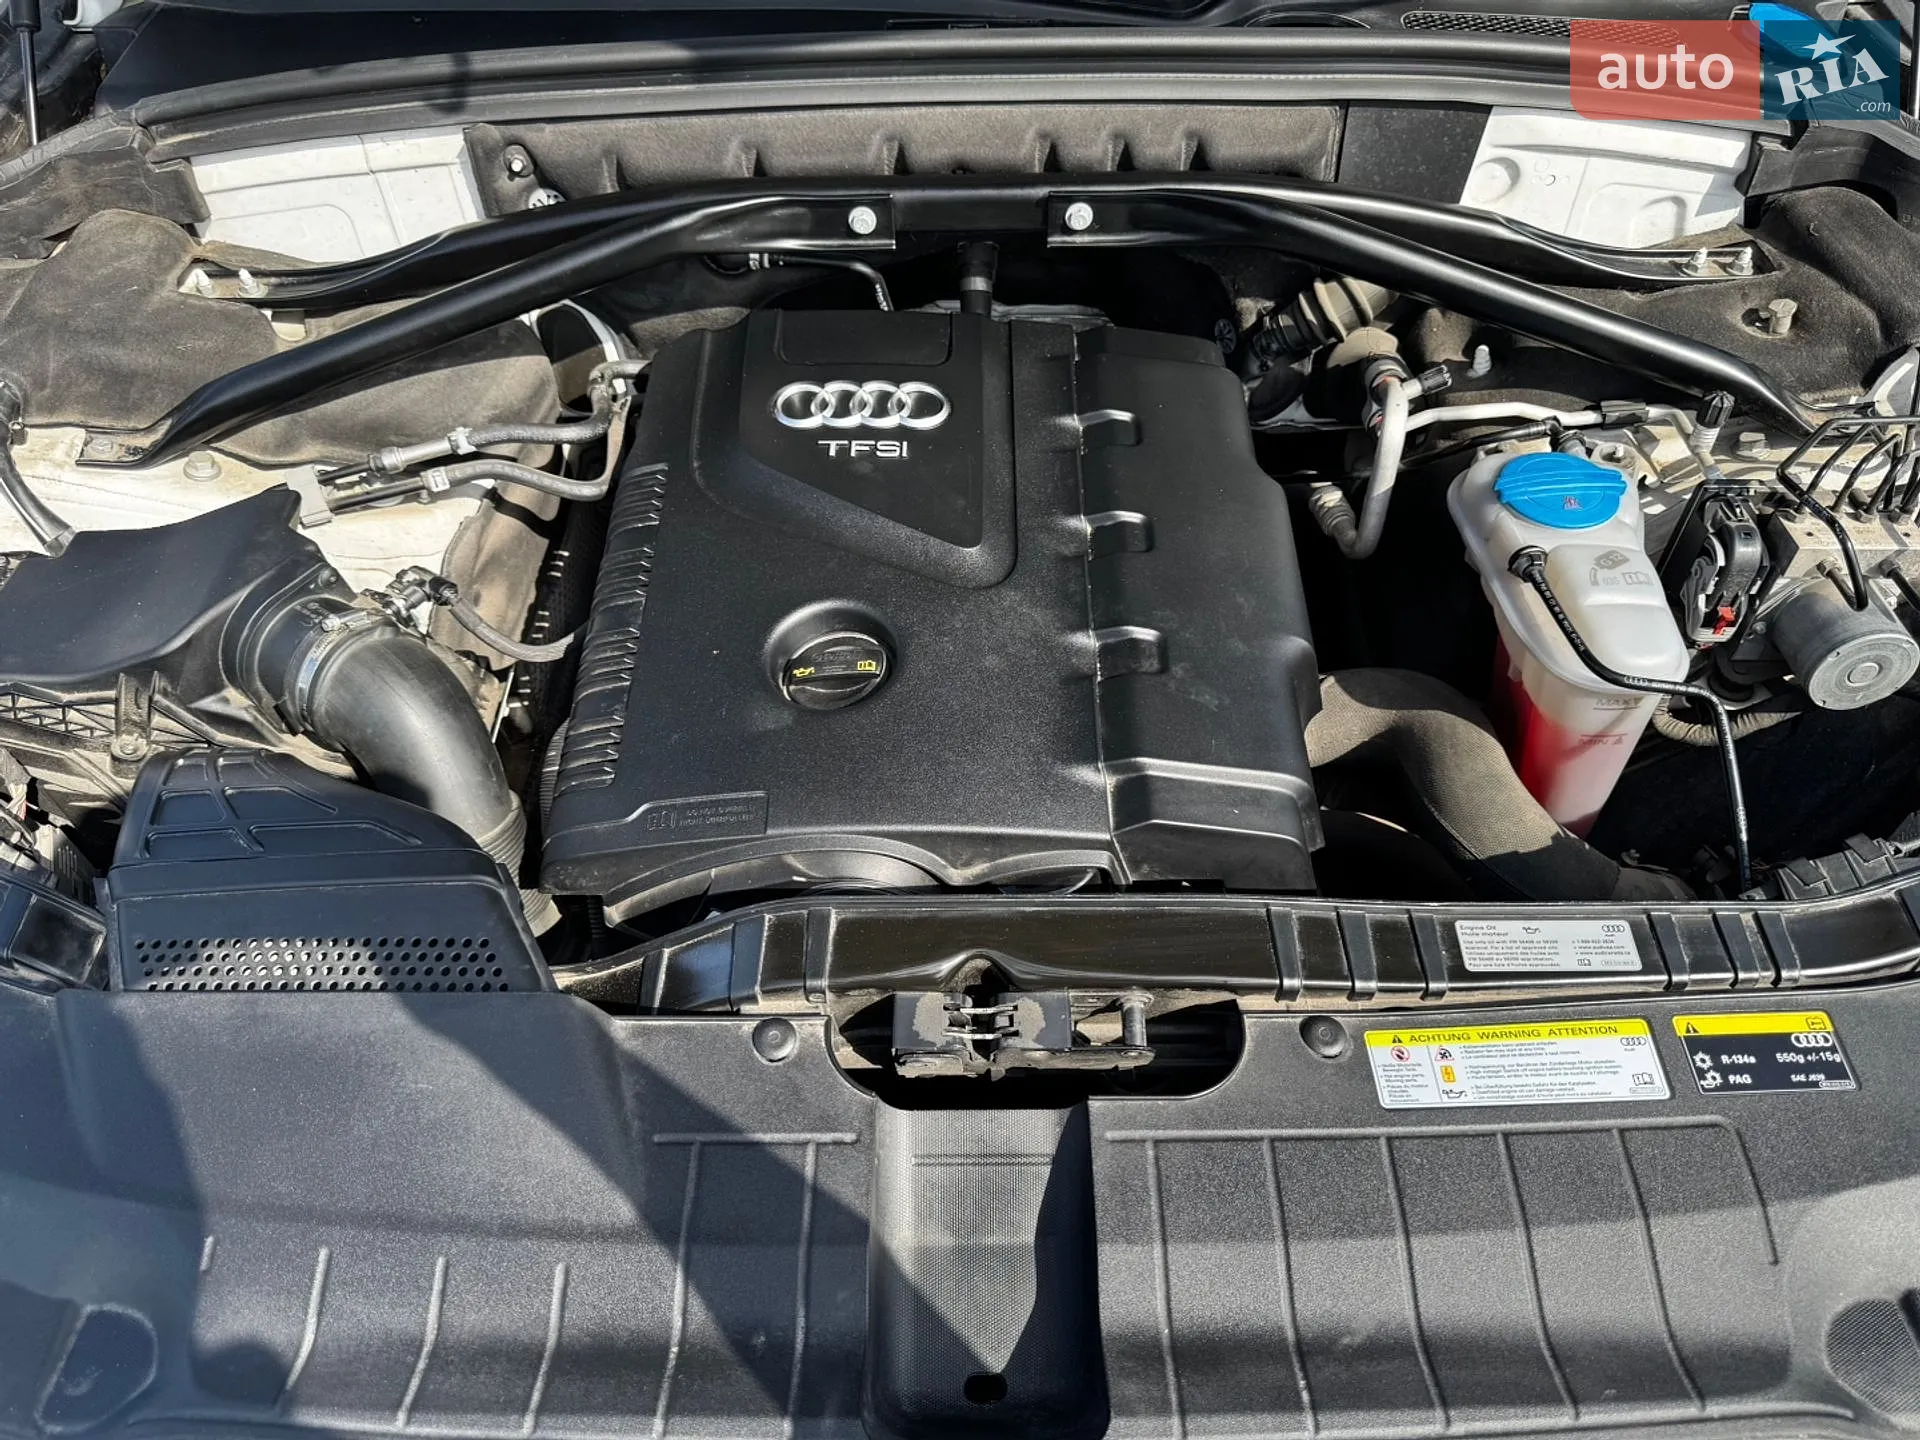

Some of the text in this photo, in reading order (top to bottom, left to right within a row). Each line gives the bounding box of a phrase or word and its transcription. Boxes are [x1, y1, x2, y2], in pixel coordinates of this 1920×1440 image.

[818, 440, 908, 457] TFSI
[1409, 1025, 1618, 1043] ACHTUNG WARNING ATTENTION
[1721, 1054, 1756, 1064] R-134a
[1775, 1053, 1805, 1064] 550g
[1728, 1074, 1752, 1084] PAG
